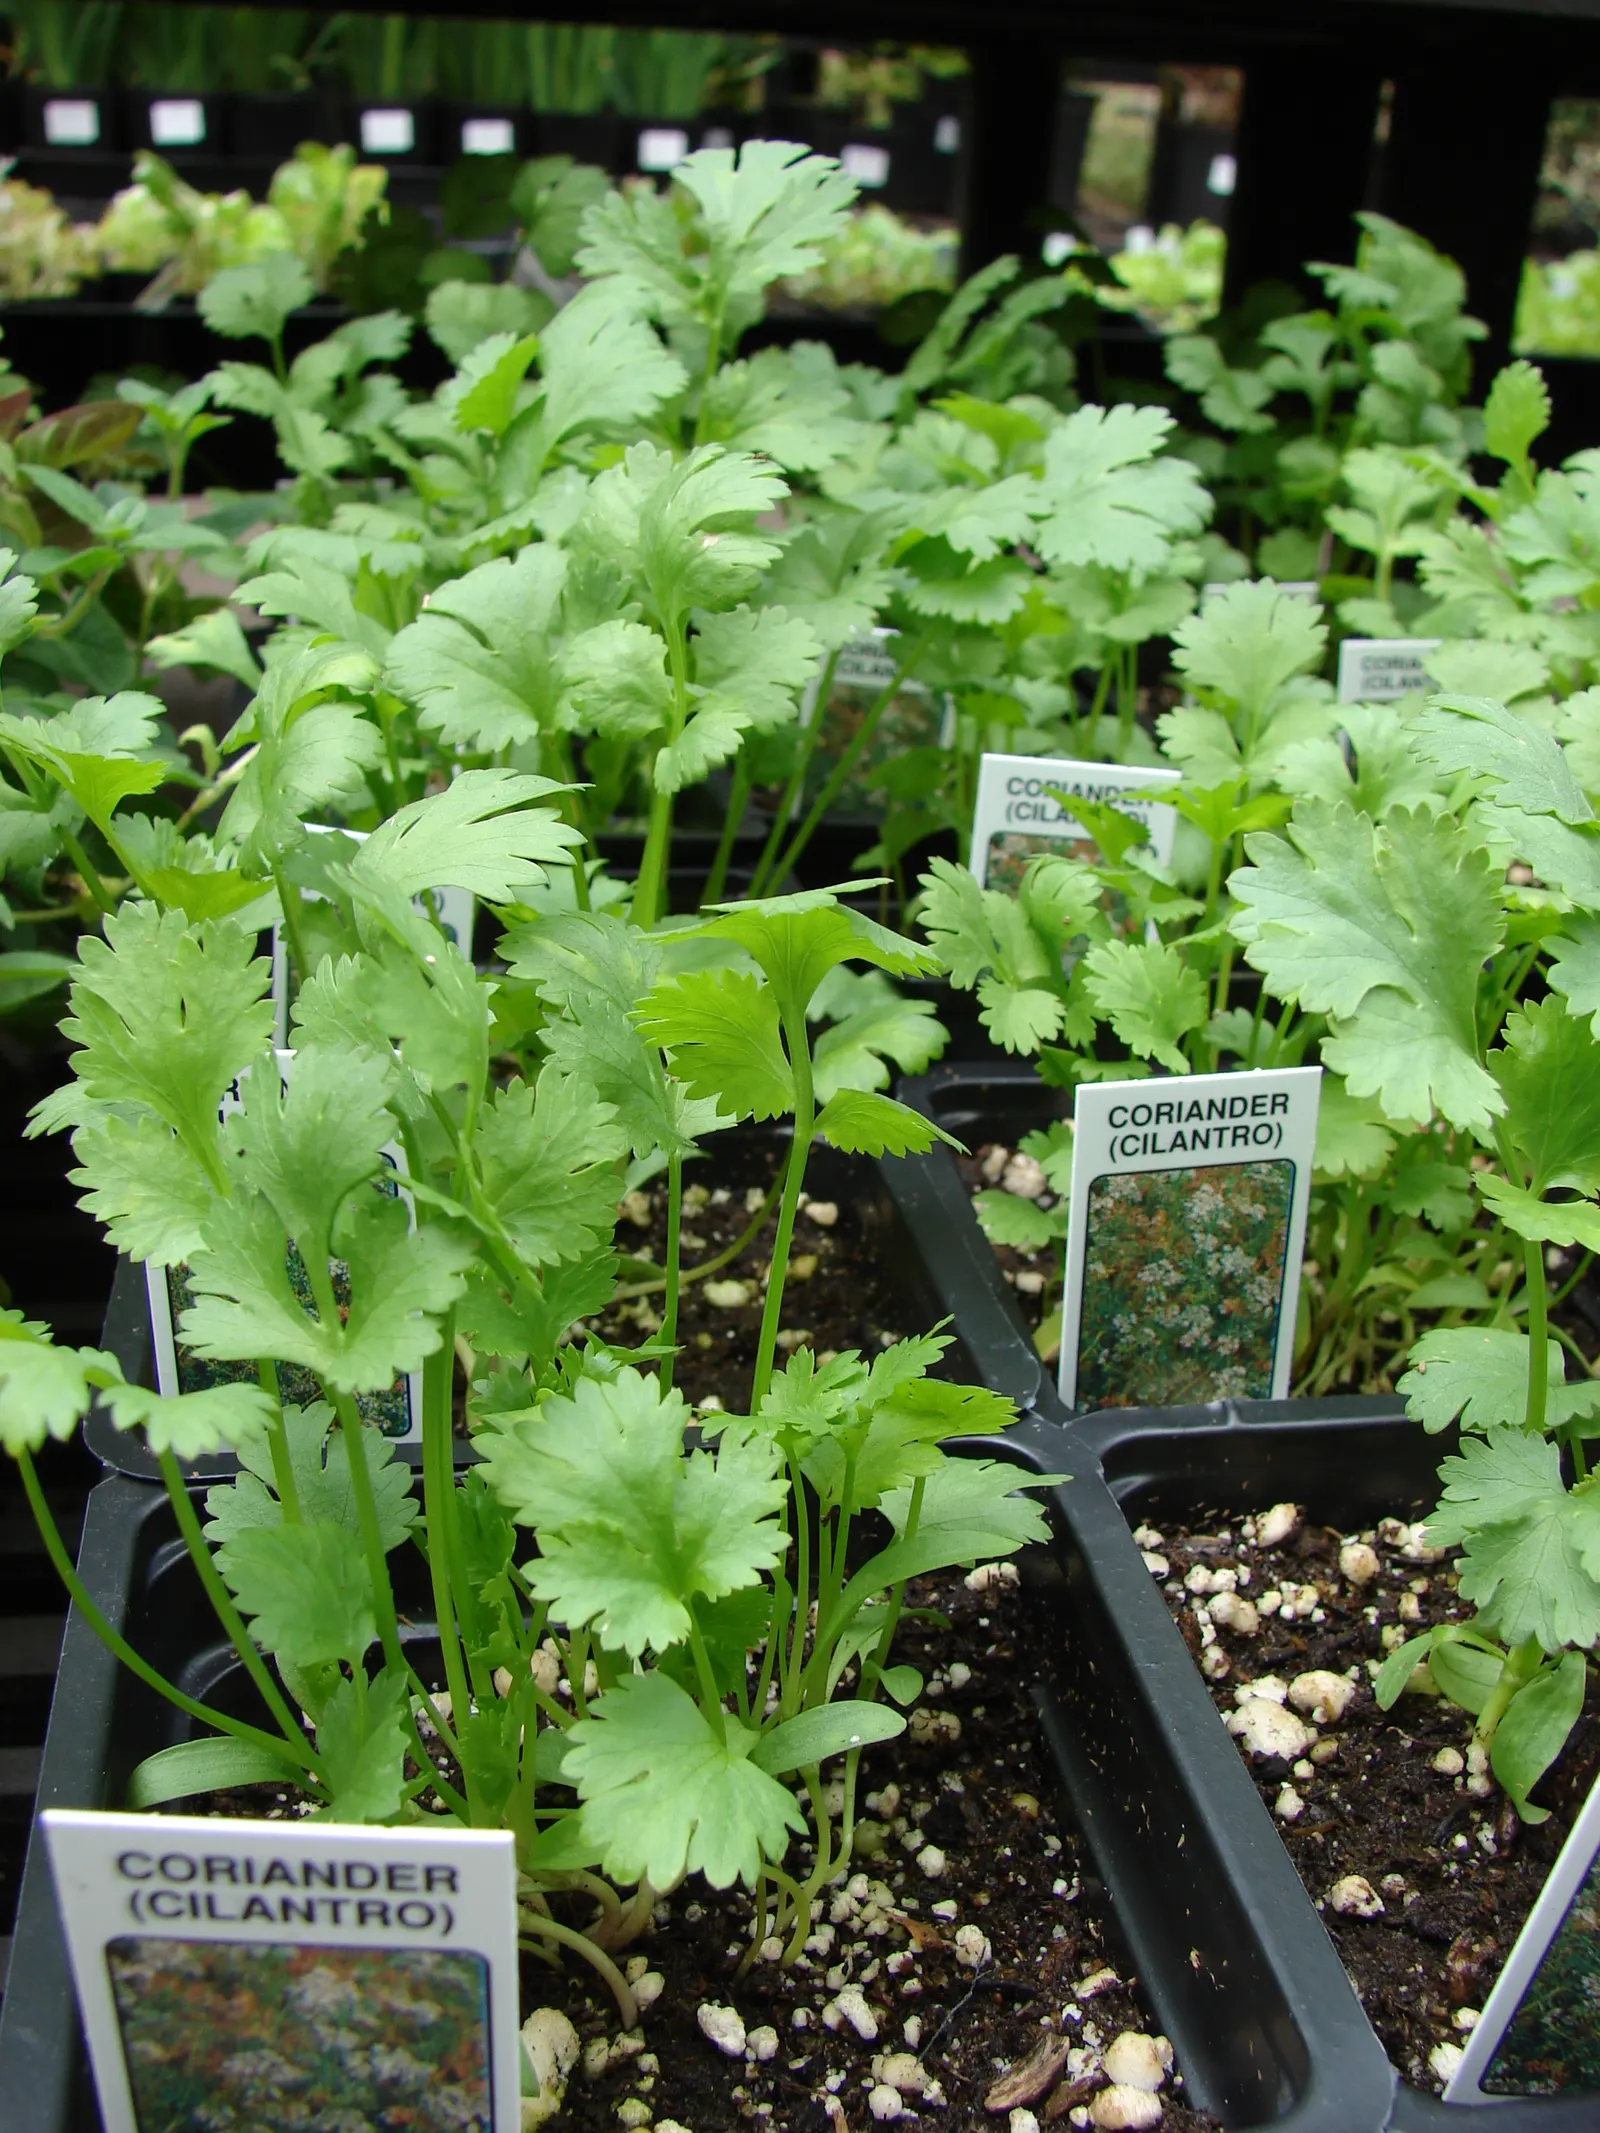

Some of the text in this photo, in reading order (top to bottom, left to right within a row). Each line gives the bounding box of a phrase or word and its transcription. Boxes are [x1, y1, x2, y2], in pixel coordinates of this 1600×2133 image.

[1108, 1092, 1290, 1129] CORIANDER
[1109, 1122, 1283, 1163] (CILANTRO)
[116, 1850, 461, 1894] CORIANDER
[130, 1888, 456, 1936] (CILANTRO)
